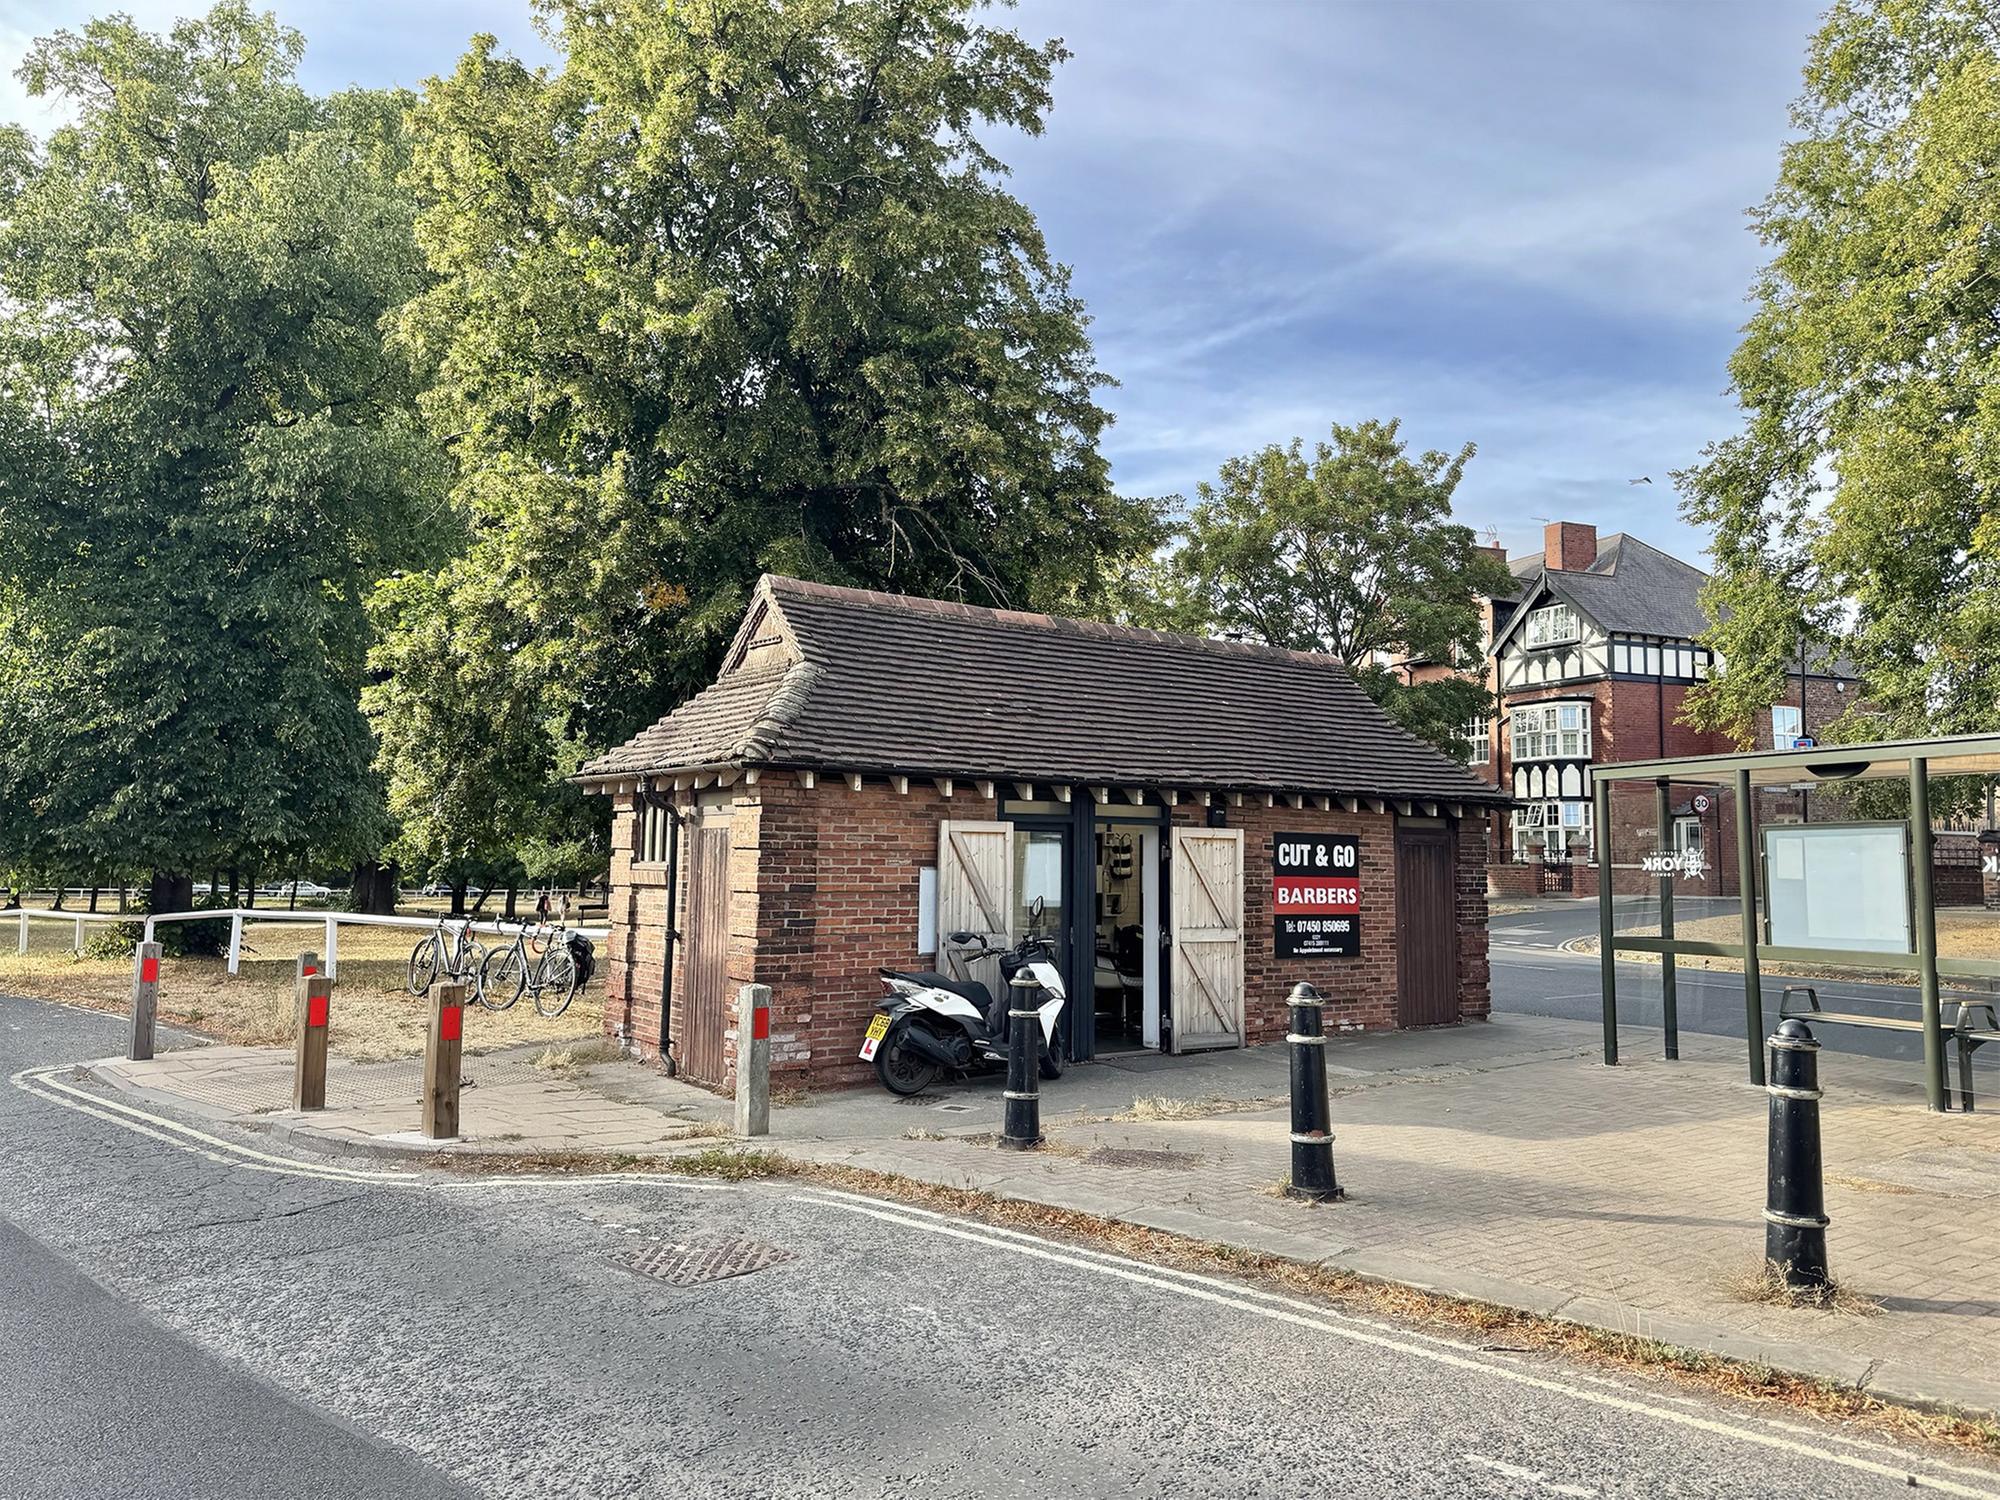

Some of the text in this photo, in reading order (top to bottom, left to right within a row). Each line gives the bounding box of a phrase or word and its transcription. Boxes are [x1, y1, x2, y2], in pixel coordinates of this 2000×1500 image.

[1695, 799, 1707, 808] 30
[1278, 843, 1355, 868] CUT & GO
[1278, 887, 1357, 904] BARBERS
[1285, 920, 1350, 932] Tel: 07450 850695
[864, 1039, 873, 1055] L
